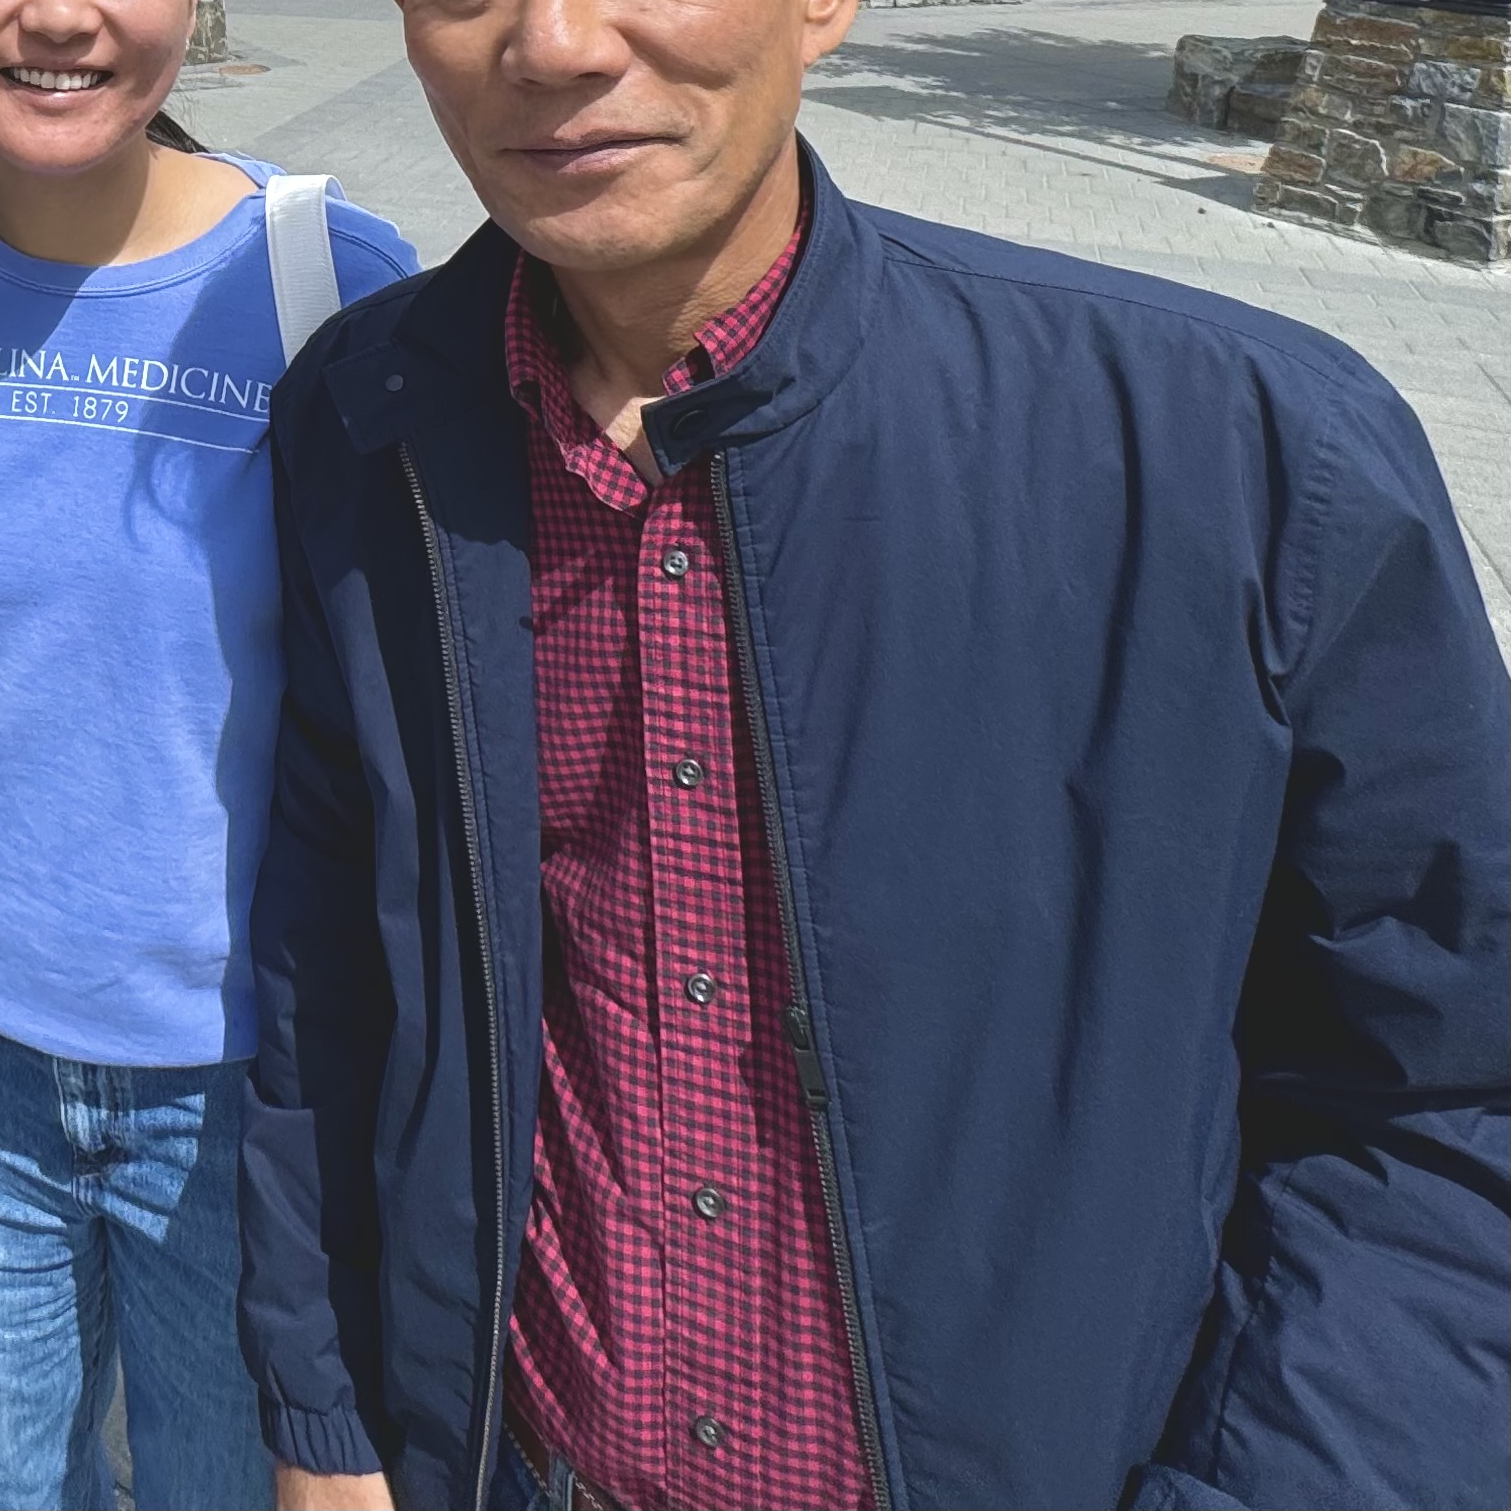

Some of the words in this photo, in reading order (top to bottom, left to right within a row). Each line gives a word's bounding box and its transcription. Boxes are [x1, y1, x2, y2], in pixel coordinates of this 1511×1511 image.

[10, 390, 56, 415] EST.
[72, 395, 129, 423] 1879
[85, 353, 273, 414] MEDICINE
